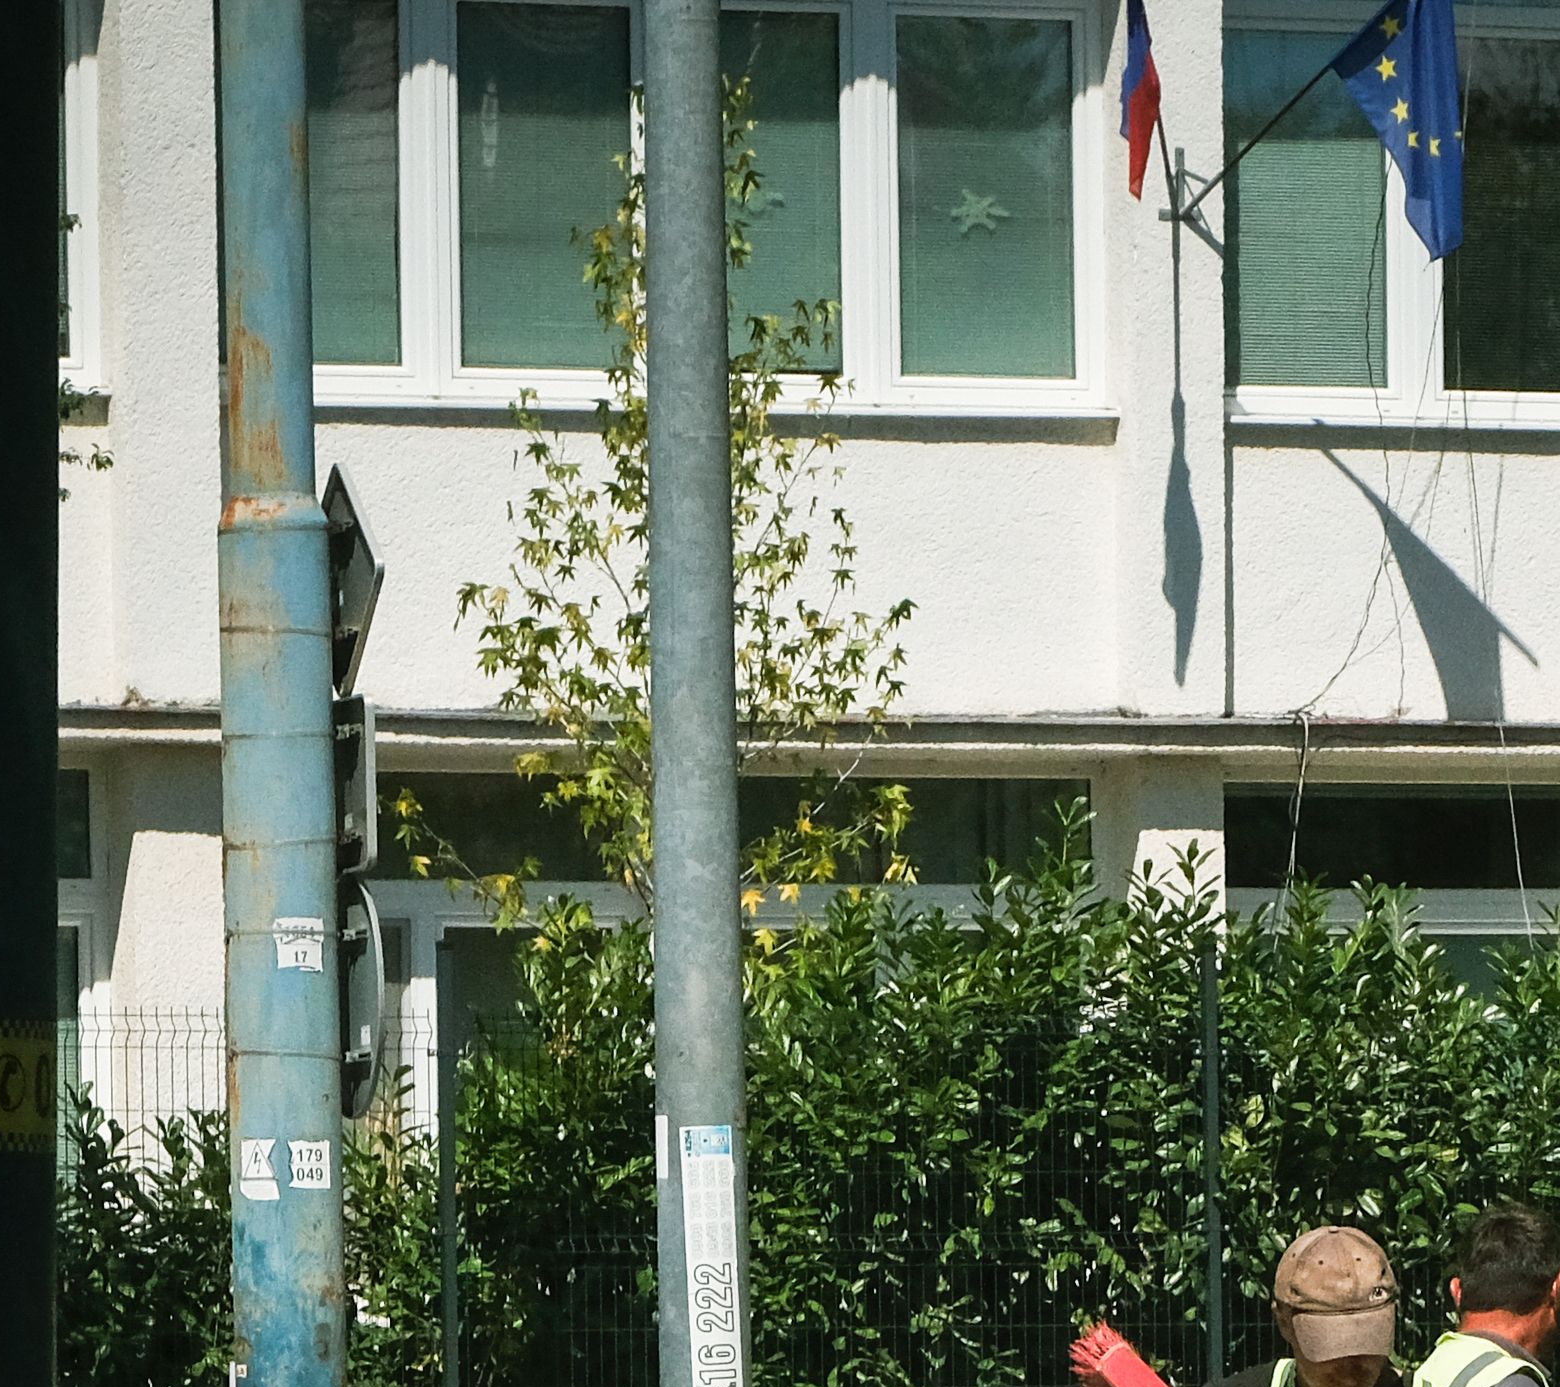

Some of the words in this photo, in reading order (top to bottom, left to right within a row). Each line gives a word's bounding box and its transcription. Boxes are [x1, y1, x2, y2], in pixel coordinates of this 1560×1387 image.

[297, 1149, 323, 1162] 179
[296, 1168, 324, 1182] 049
[693, 1262, 736, 1334] 222
[698, 1342, 737, 1386] 16
